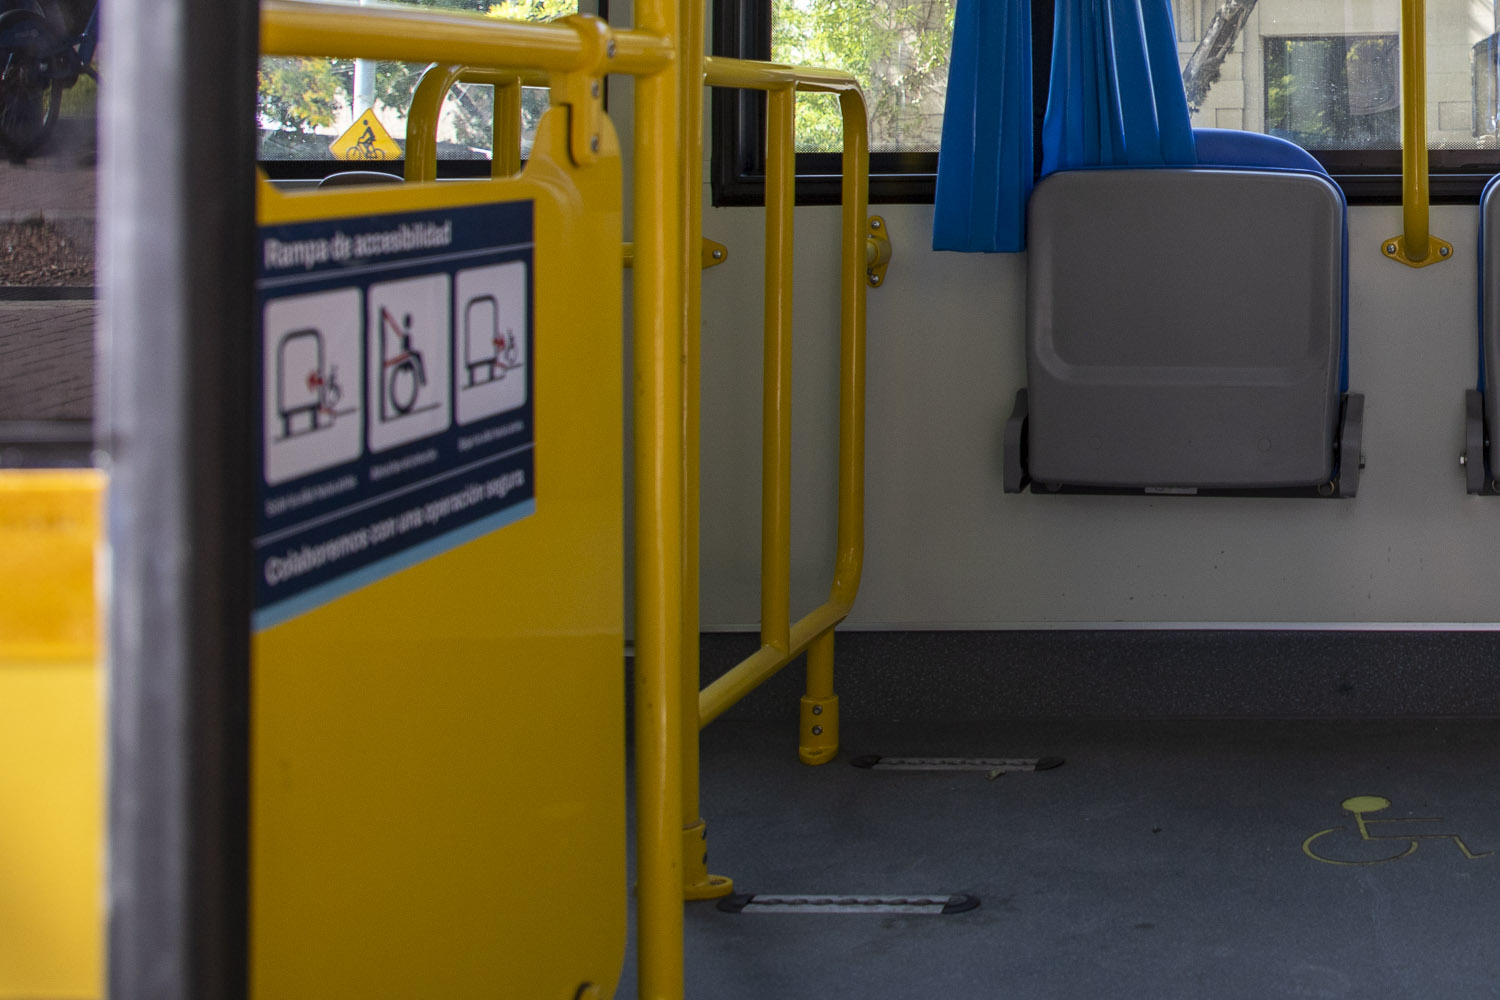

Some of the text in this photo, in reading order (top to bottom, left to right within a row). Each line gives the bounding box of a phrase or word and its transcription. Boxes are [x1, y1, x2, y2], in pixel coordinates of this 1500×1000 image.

[264, 219, 452, 270] Rampa de accesibilidad
[265, 469, 526, 586] Colaboremos con una operación segura
